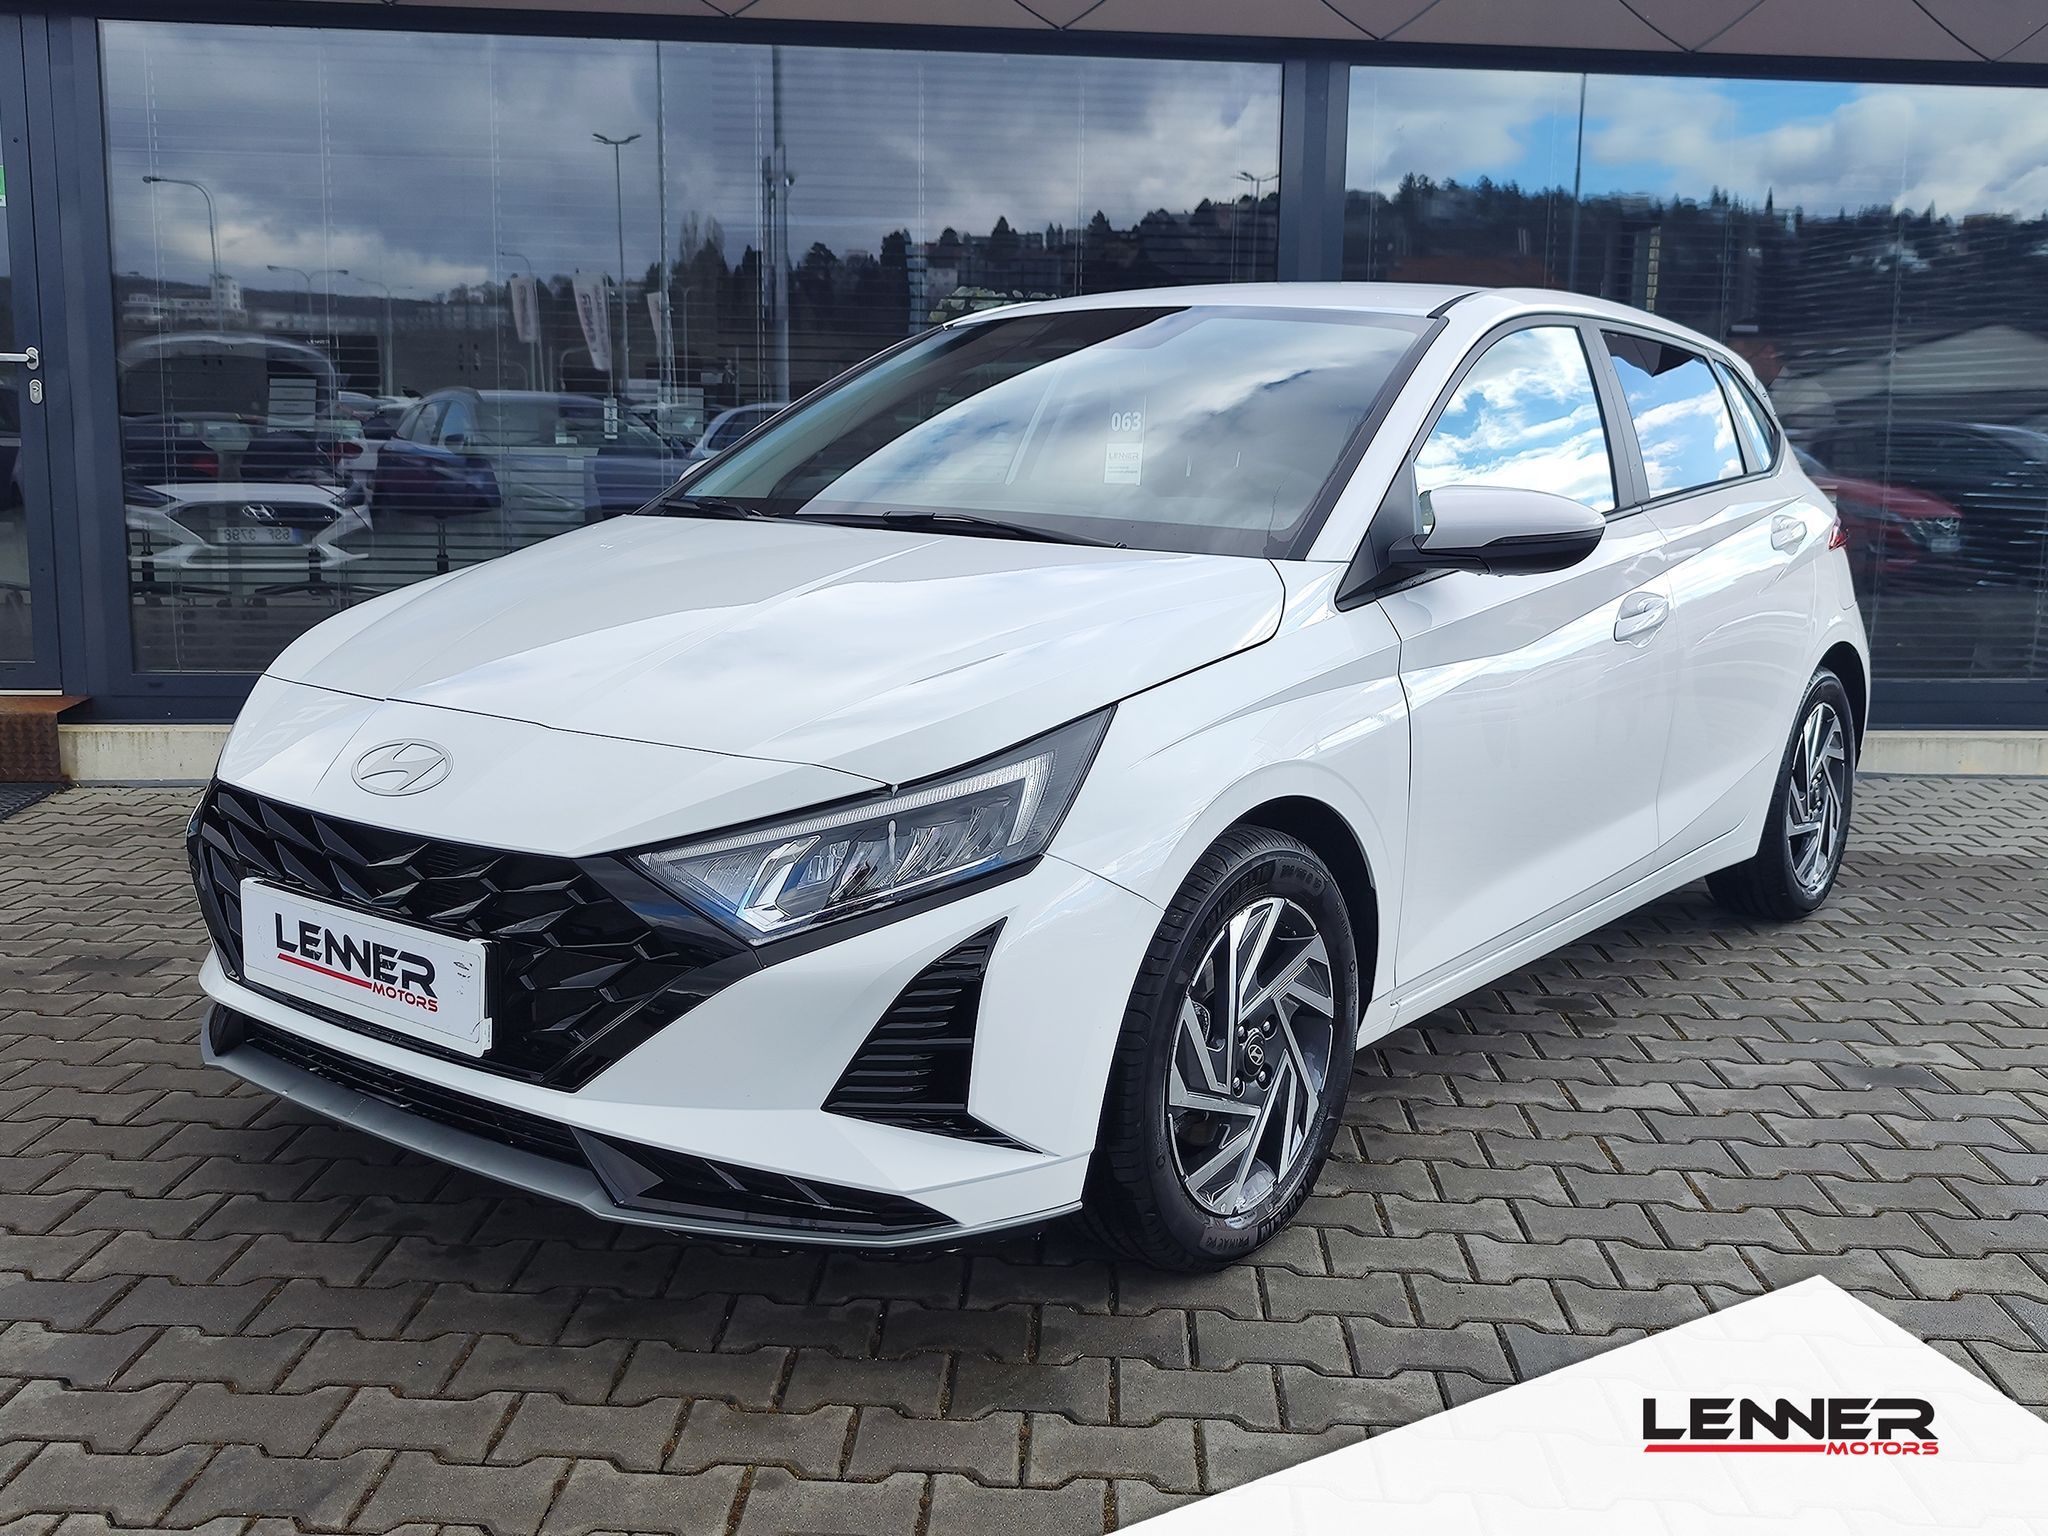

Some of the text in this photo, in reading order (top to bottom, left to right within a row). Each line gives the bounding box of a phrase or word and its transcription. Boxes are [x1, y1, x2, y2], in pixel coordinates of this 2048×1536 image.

[1111, 411, 1142, 432] 063
[275, 912, 438, 999] LENNER
[372, 981, 438, 1013] MOTORS
